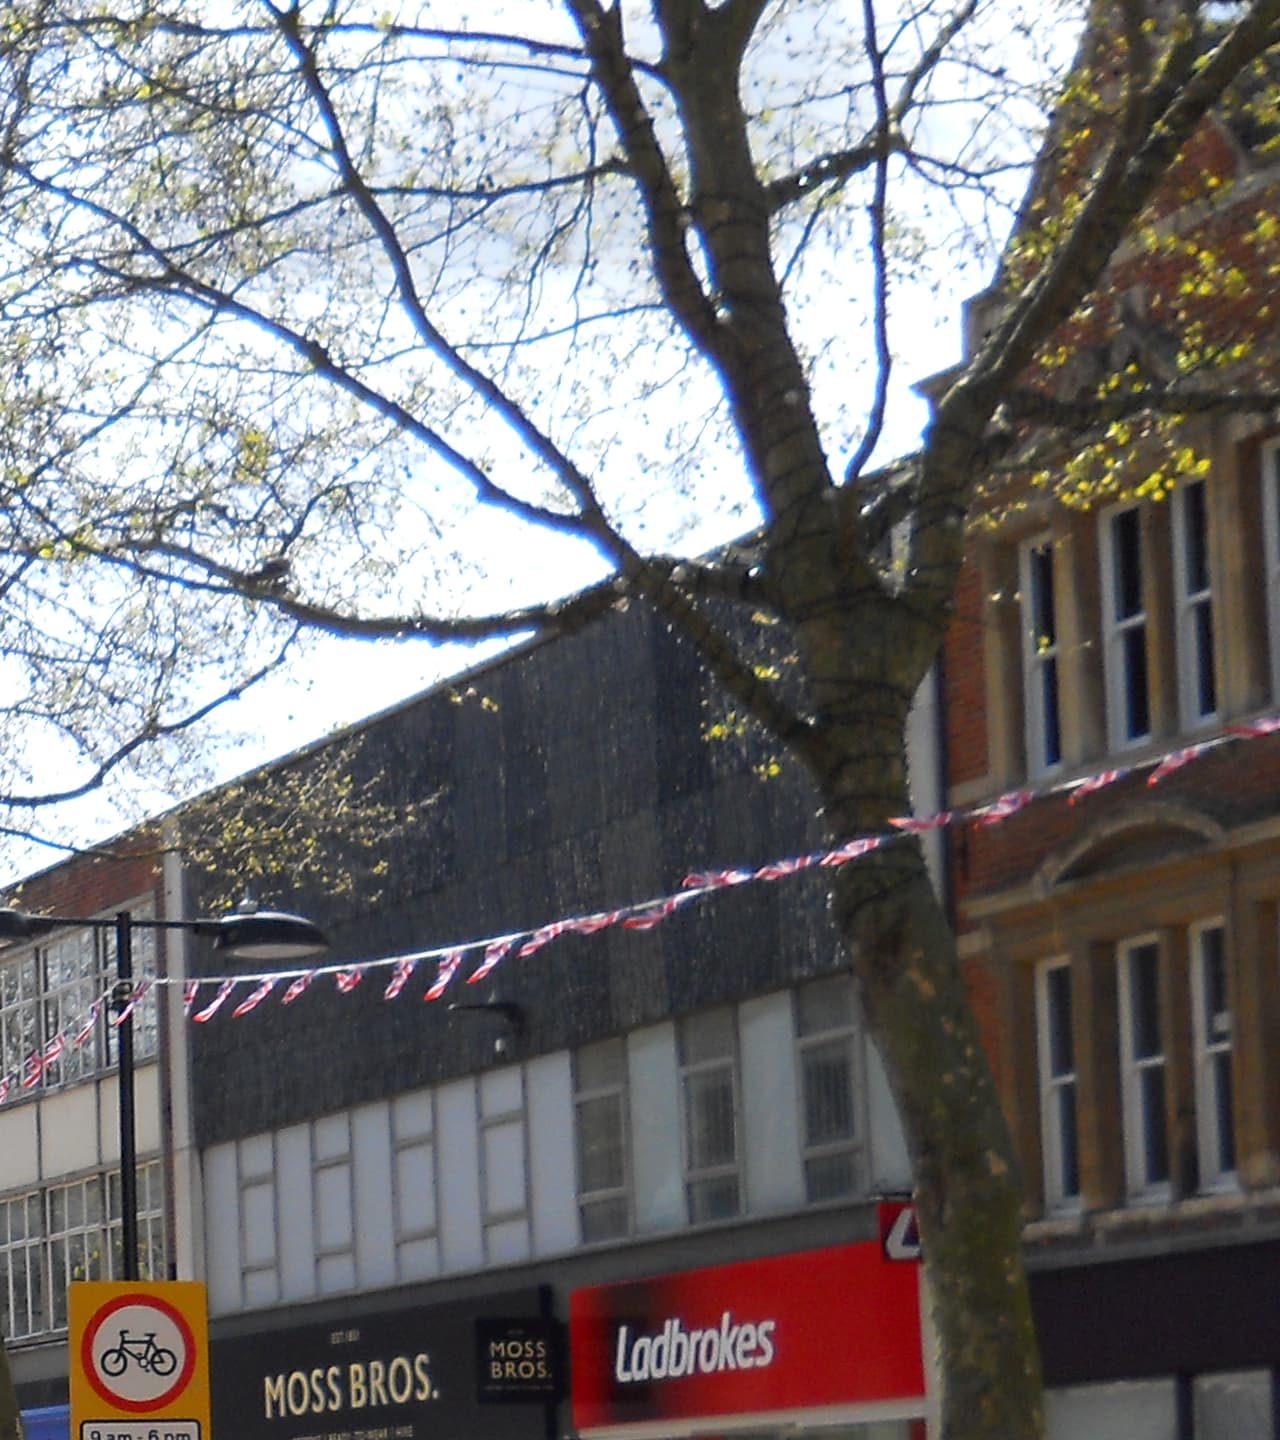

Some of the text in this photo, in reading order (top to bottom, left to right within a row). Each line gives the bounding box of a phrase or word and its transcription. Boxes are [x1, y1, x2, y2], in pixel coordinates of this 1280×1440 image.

[489, 1340, 546, 1359] MOSS
[615, 1311, 777, 1384] Ladbrokes
[264, 1353, 439, 1420] MOSS BROS.
